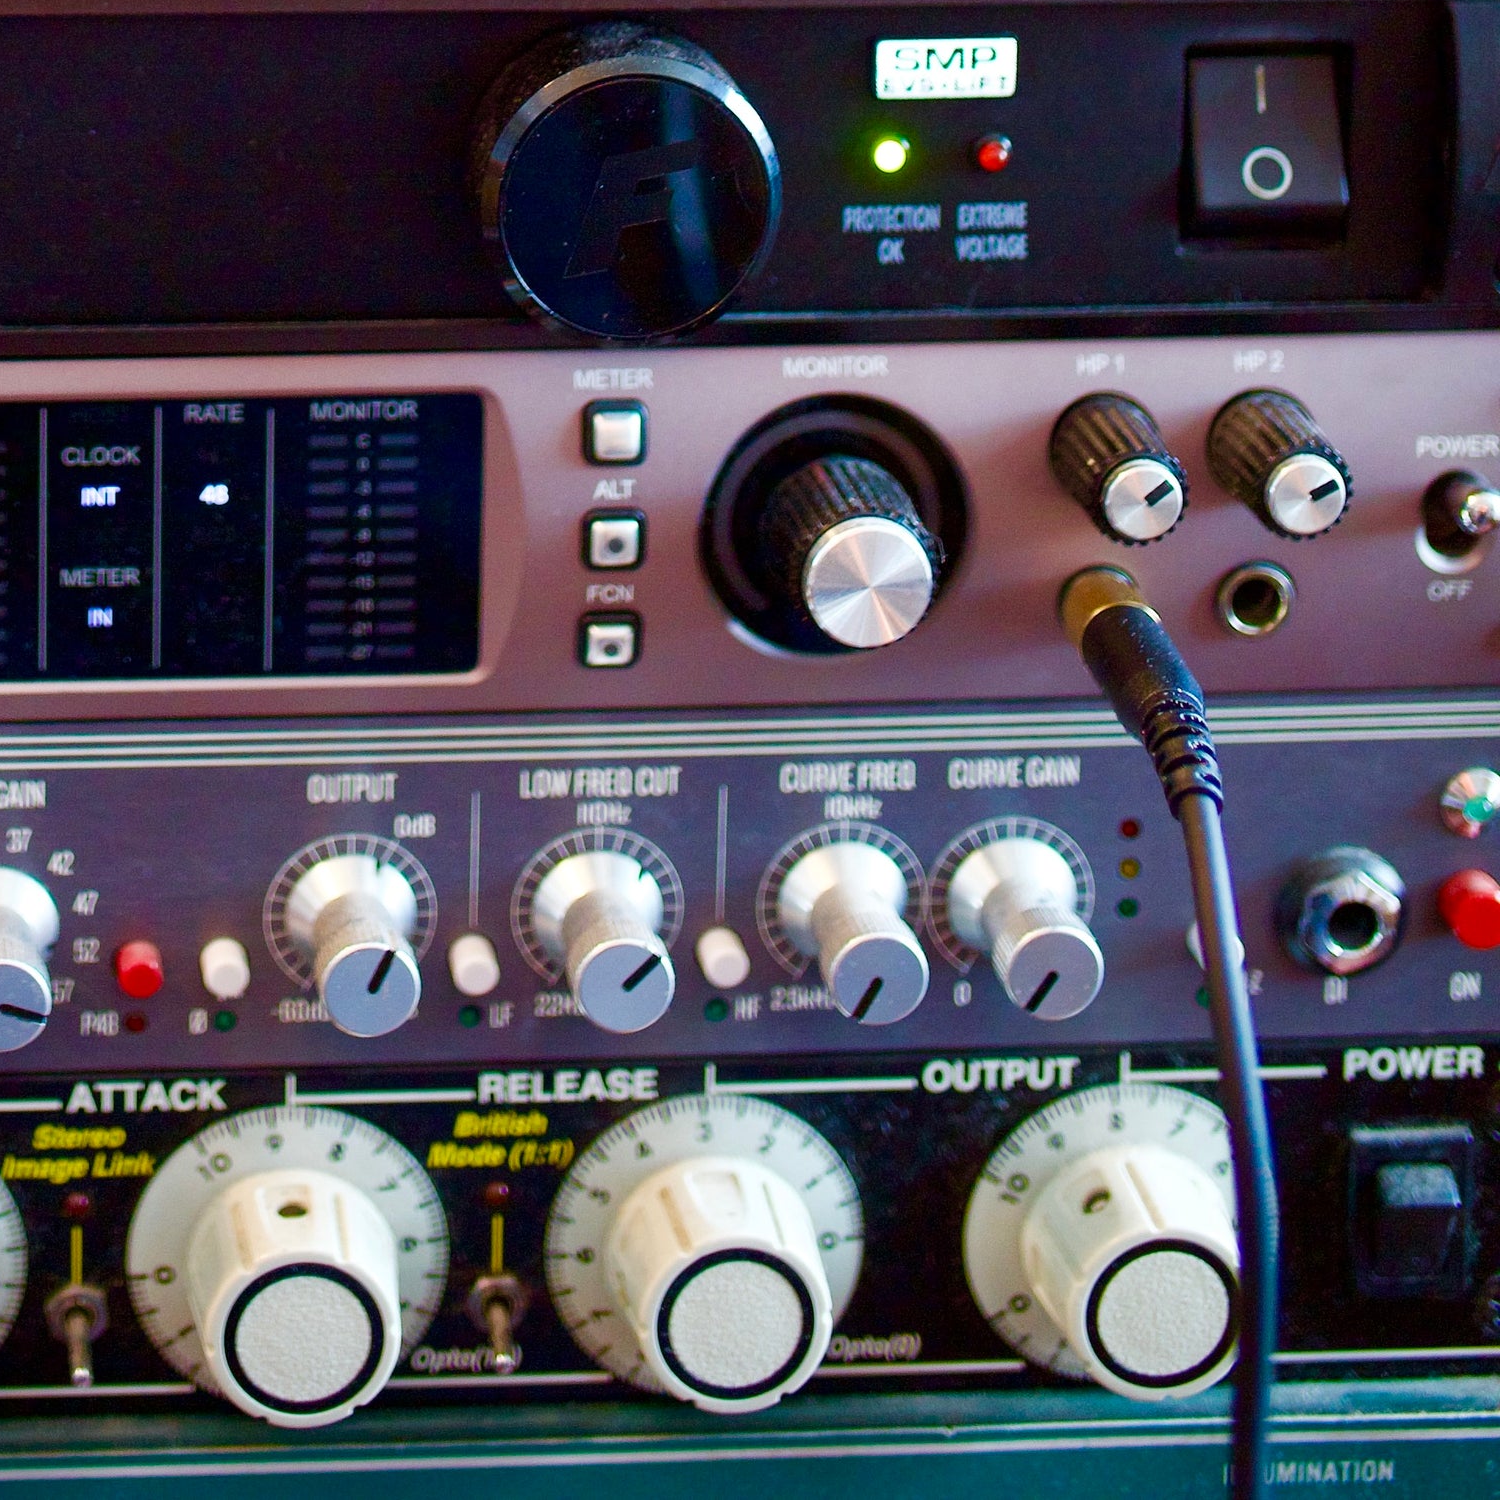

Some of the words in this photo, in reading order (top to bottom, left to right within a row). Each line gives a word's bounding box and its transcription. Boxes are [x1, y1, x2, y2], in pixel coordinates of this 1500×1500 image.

[894, 45, 998, 71] SMP
[842, 203, 942, 233] PROTECTION
[956, 200, 1029, 231] EXTREME
[876, 236, 906, 266] OK
[954, 231, 1029, 262] VOLTAGE
[782, 354, 889, 380] MONITOR
[1075, 352, 1108, 376] HP
[1232, 350, 1264, 374] HP
[573, 367, 654, 391] METER
[183, 403, 245, 424] RATE
[309, 400, 419, 421] MONITOR
[60, 446, 141, 467] CLOCK
[1416, 435, 1500, 459] POWER
[80, 485, 121, 507] INT
[199, 484, 230, 506] 48
[593, 479, 636, 501] ALT
[59, 566, 141, 588] METER
[586, 585, 636, 603] FCN
[1427, 580, 1473, 602] OFF
[87, 607, 114, 628] IN
[519, 769, 572, 799] LOW
[573, 767, 632, 798] FREQ
[635, 766, 682, 796] CUT
[780, 762, 855, 793] CURVE
[856, 760, 917, 791] FREQ
[948, 758, 1024, 788] CURVE
[1025, 756, 1081, 787] GAIN
[307, 773, 398, 803] OUTPUT
[1449, 971, 1483, 1002] ON
[534, 992, 585, 1017] 22H
[920, 1056, 1080, 1094] OUTPUT
[1342, 1046, 1485, 1082] POWER
[65, 1080, 227, 1115] ATTACK
[476, 1068, 659, 1105] RELEASE
[32, 1124, 127, 1150] Stereo
[453, 1111, 550, 1138] British
[2, 1154, 90, 1183] Image
[92, 1151, 156, 1178] Link
[426, 1141, 507, 1168] Mode
[1222, 1460, 1395, 1487] IUMINATION
